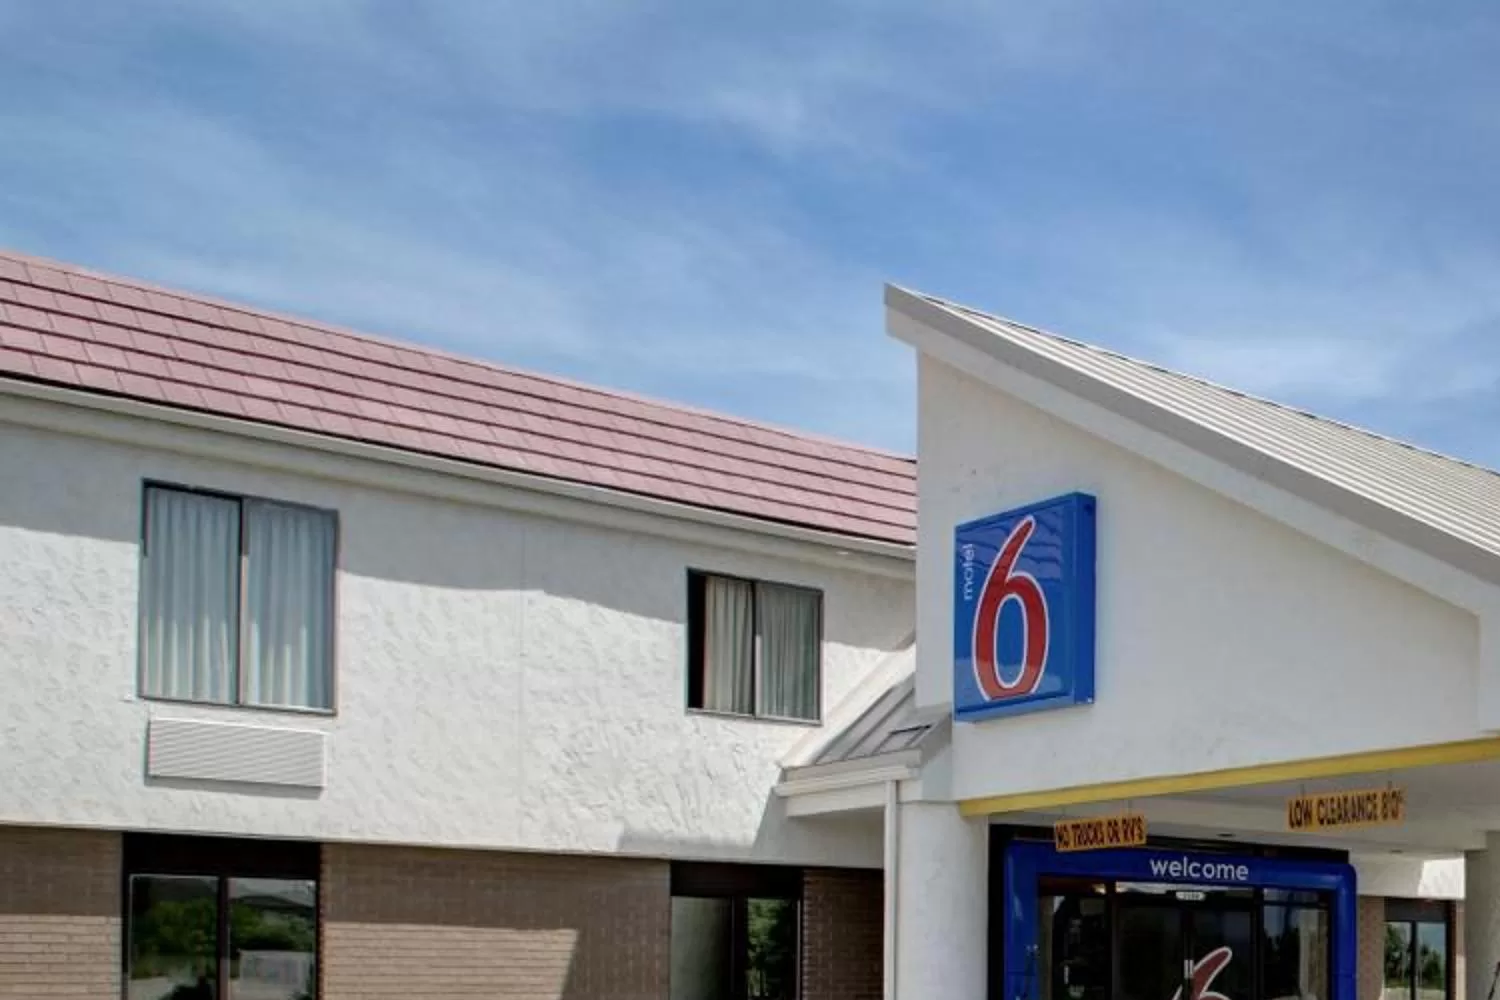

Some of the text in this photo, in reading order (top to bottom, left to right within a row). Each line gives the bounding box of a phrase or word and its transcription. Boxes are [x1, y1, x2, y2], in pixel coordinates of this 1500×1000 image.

[962, 543, 974, 601] motel
[972, 514, 1049, 702] 6
[1288, 798, 1313, 829] LOW
[1317, 792, 1378, 825] CLEARANCE
[1071, 820, 1105, 848] TRUCKS
[1149, 855, 1249, 881] welcome
